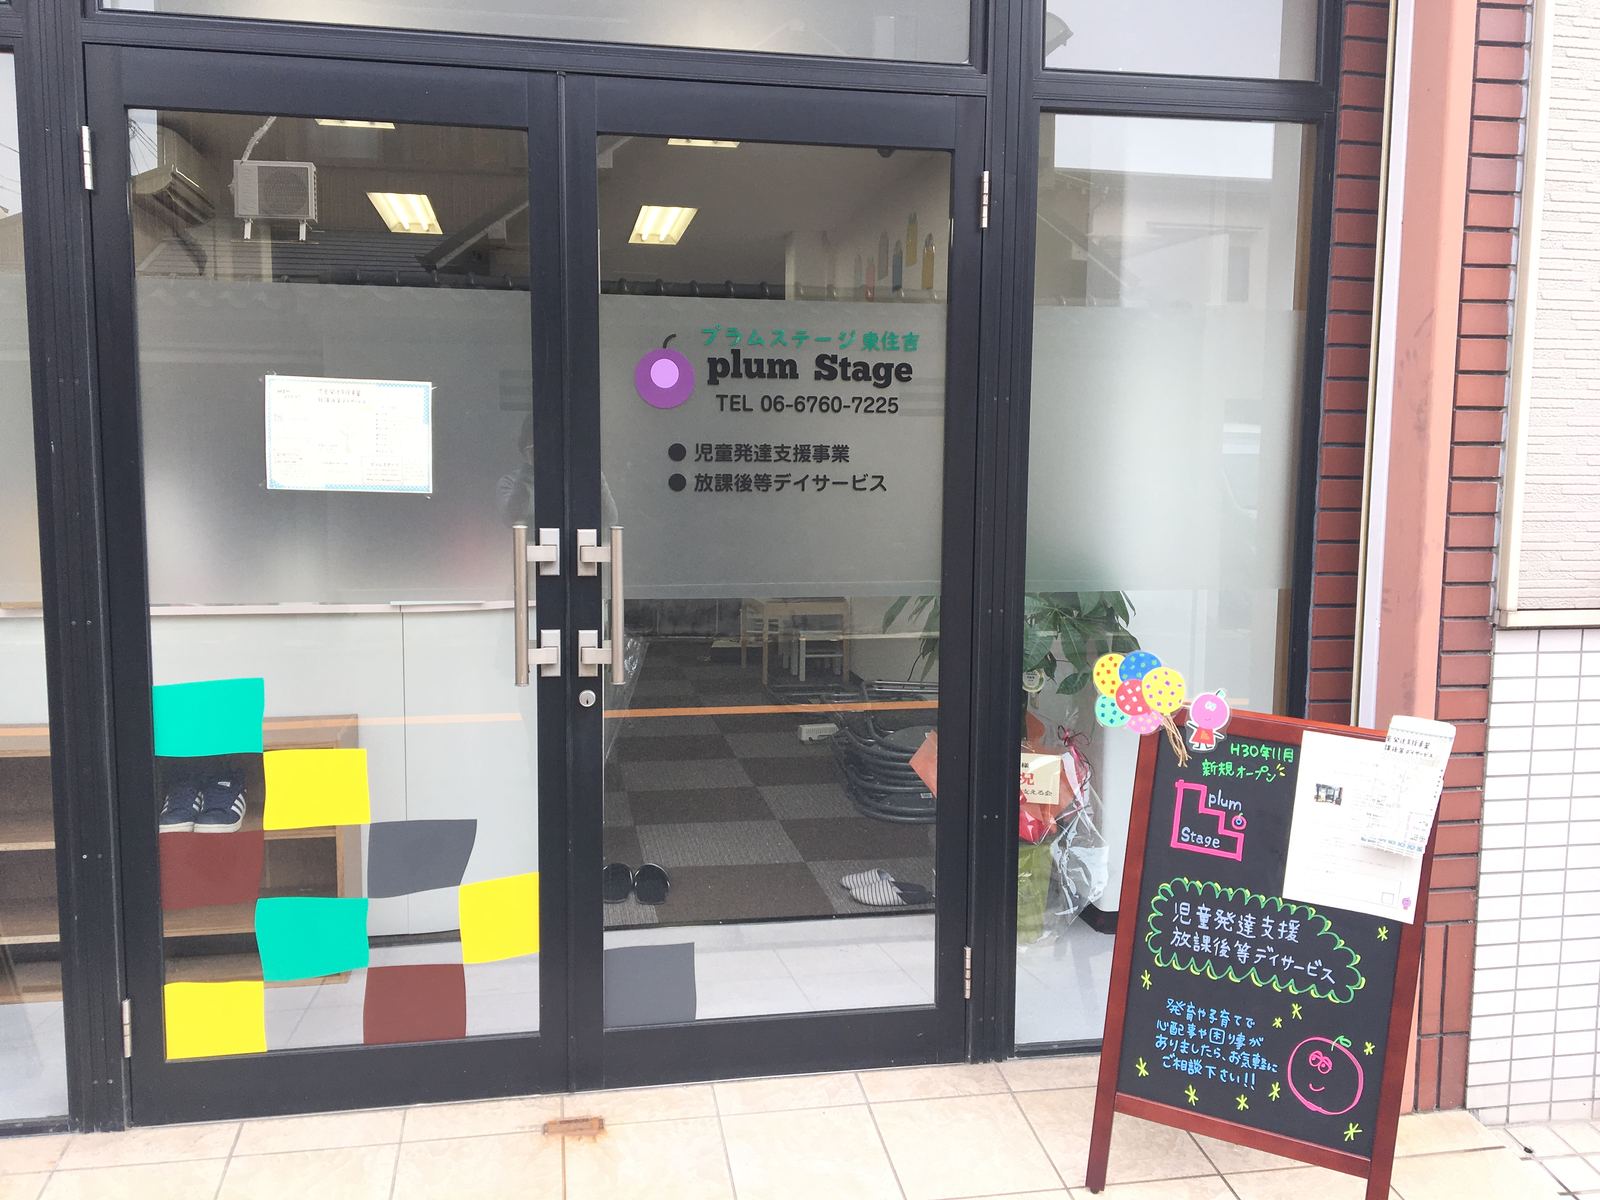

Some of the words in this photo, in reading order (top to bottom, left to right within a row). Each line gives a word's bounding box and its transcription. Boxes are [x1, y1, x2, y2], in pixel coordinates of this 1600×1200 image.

[707, 349, 799, 385] plum
[814, 353, 913, 388] Stage
[716, 394, 753, 412] TEL
[760, 395, 899, 413] 06-6760-7225
[694, 443, 850, 463] 児童発達支援事業
[694, 473, 888, 492] 放課後等デイサービス
[1230, 742, 1295, 763] H30年11月
[1202, 758, 1276, 782] 新規オープン
[1208, 789, 1242, 812] plum
[1180, 826, 1221, 849] Stage
[1172, 901, 1301, 944] 児童発達支援
[1170, 926, 1336, 985] 放課後等デイサービス
[1166, 998, 1256, 1028] 発育や子育てで
